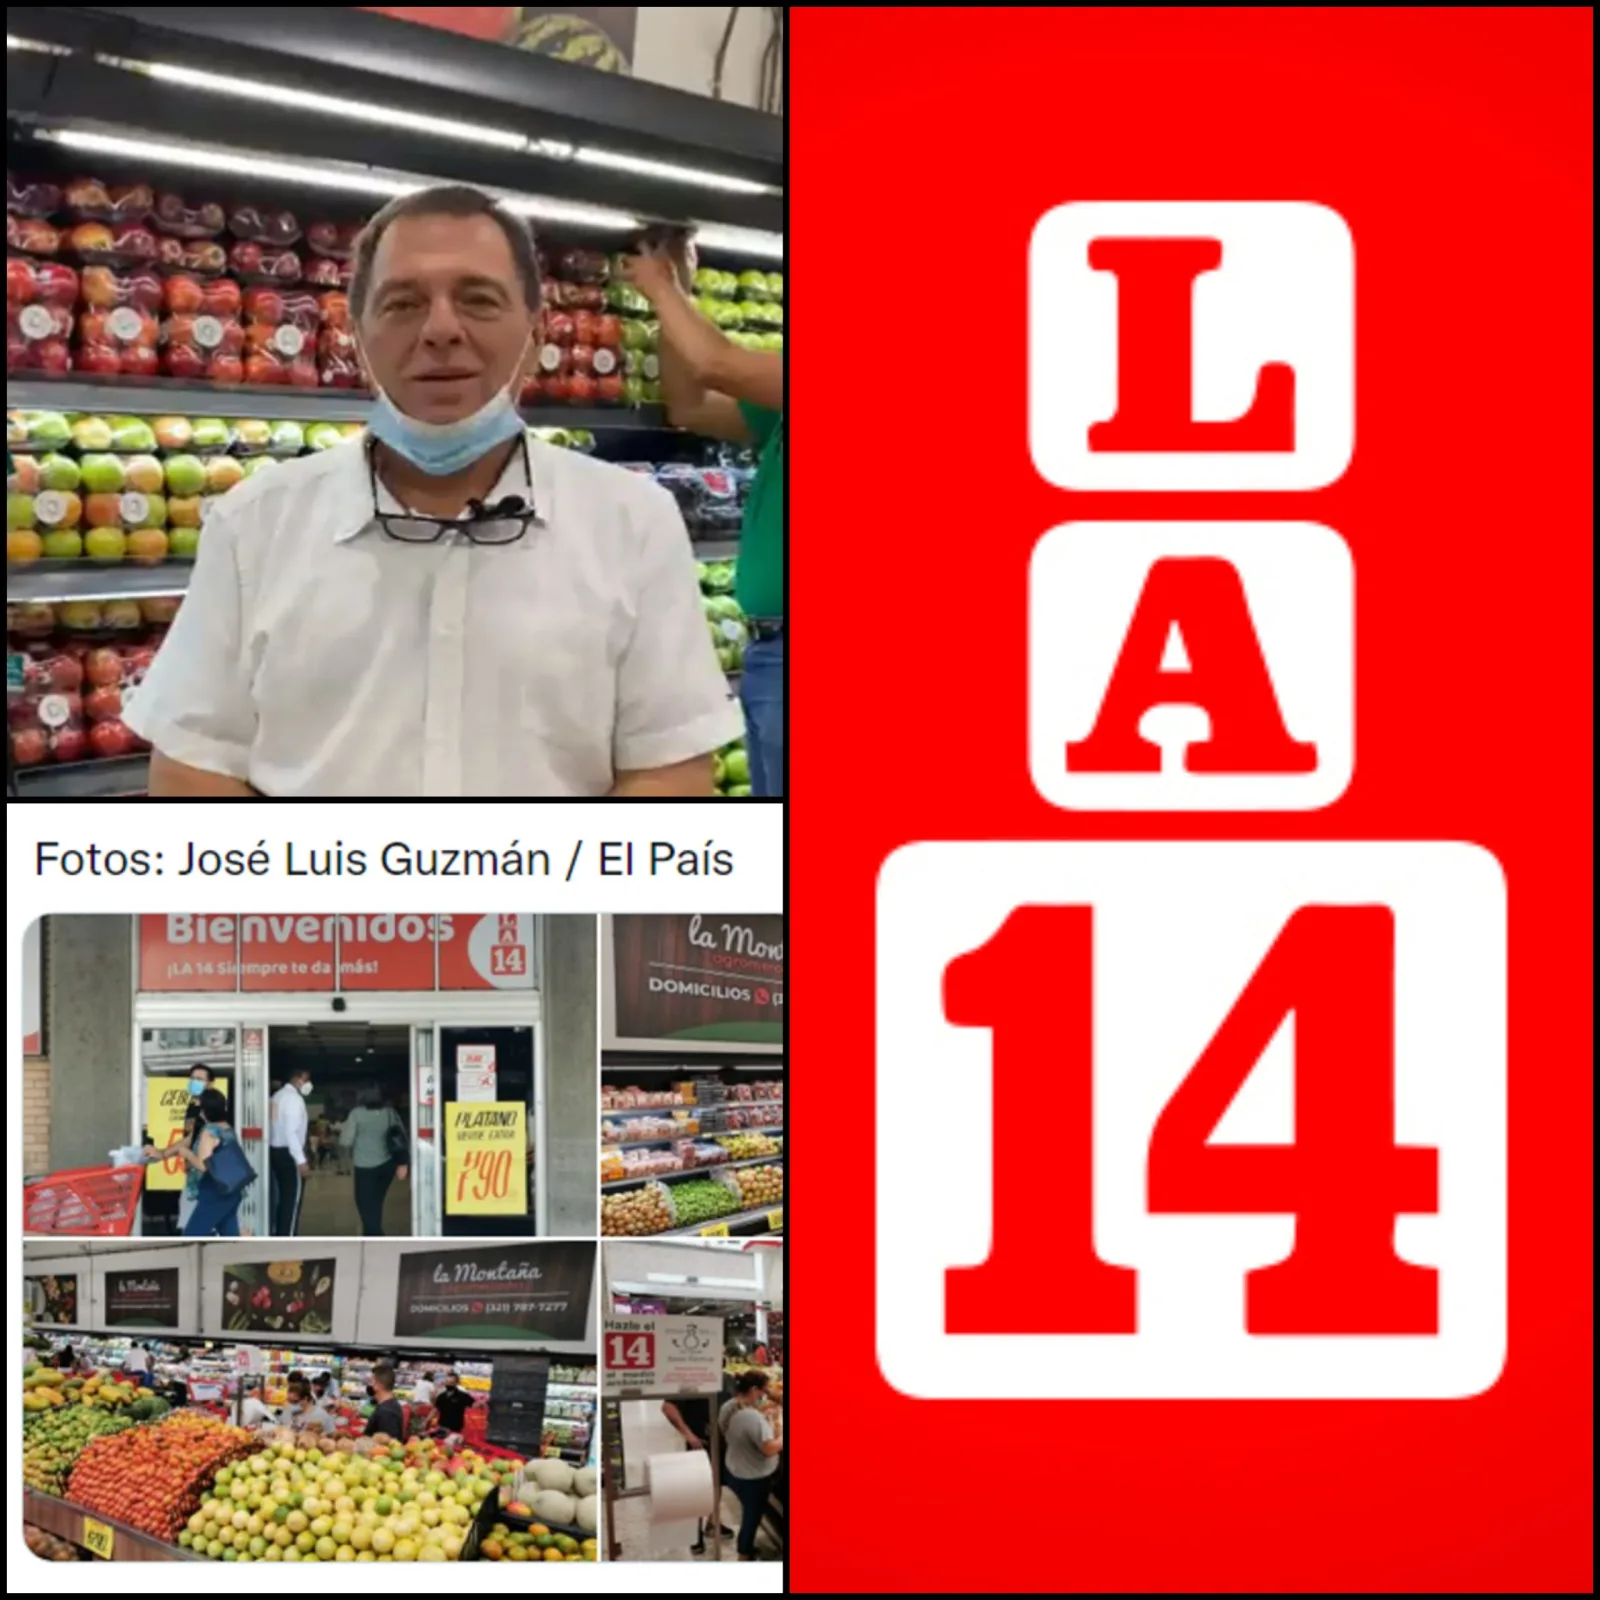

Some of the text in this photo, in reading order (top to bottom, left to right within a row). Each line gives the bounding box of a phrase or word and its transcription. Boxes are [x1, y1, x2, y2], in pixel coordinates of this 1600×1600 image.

[166, 914, 455, 943] Bienvenidos
[688, 914, 717, 949] la
[291, 962, 308, 975] te
[311, 961, 332, 975] da
[494, 948, 523, 972] 14
[648, 977, 751, 1001] DOMICILIOS
[941, 903, 1439, 1336] 14
[609, 1335, 651, 1366] 14
